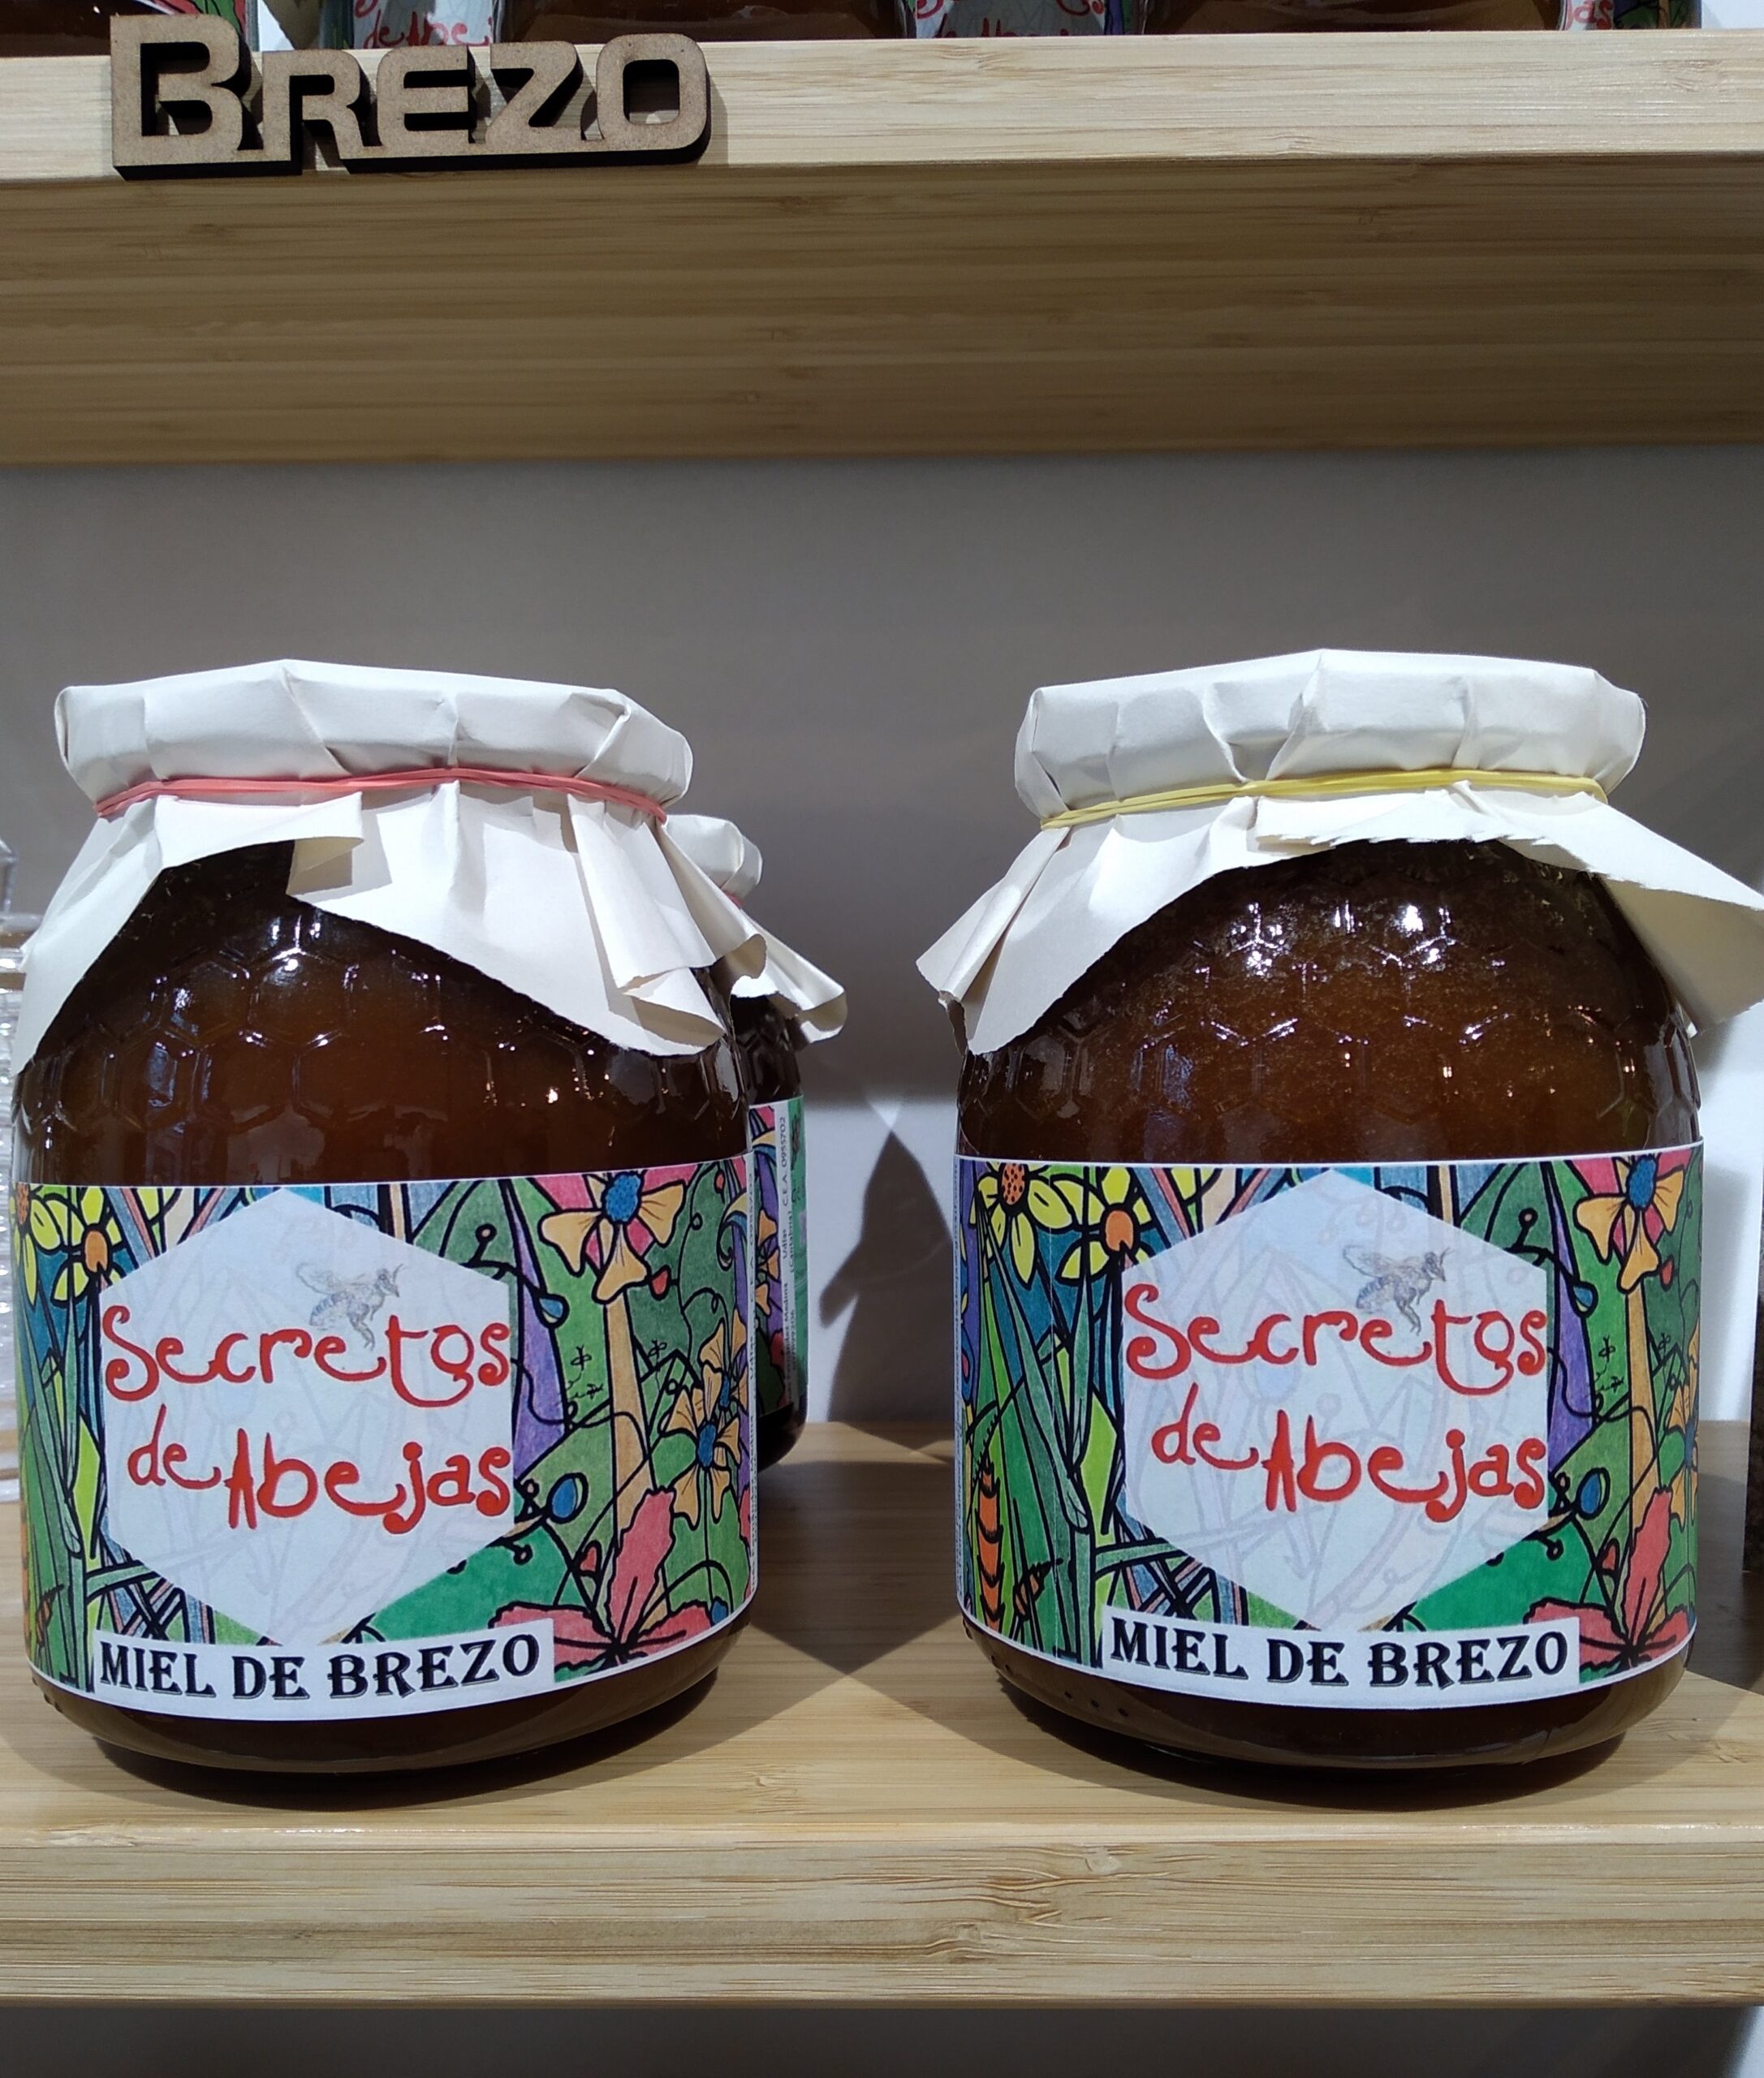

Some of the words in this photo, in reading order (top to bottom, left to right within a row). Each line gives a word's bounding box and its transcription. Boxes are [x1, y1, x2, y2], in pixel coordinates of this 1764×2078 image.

[110, 13, 709, 175] BREZO
[102, 1305, 511, 1408] Secretos
[1124, 1283, 1548, 1396] Secretos
[127, 1404, 222, 1490] de
[225, 1429, 511, 1534] Abejas
[1151, 1382, 1259, 1471] de
[1262, 1410, 1547, 1523] Abejas
[99, 1640, 216, 1698] MIEL
[232, 1655, 309, 1701] DE
[327, 1634, 540, 1701] BREZO
[1110, 1616, 1249, 1681] MIEL
[1266, 1638, 1349, 1688] DE
[1369, 1632, 1568, 1690] BREZO
